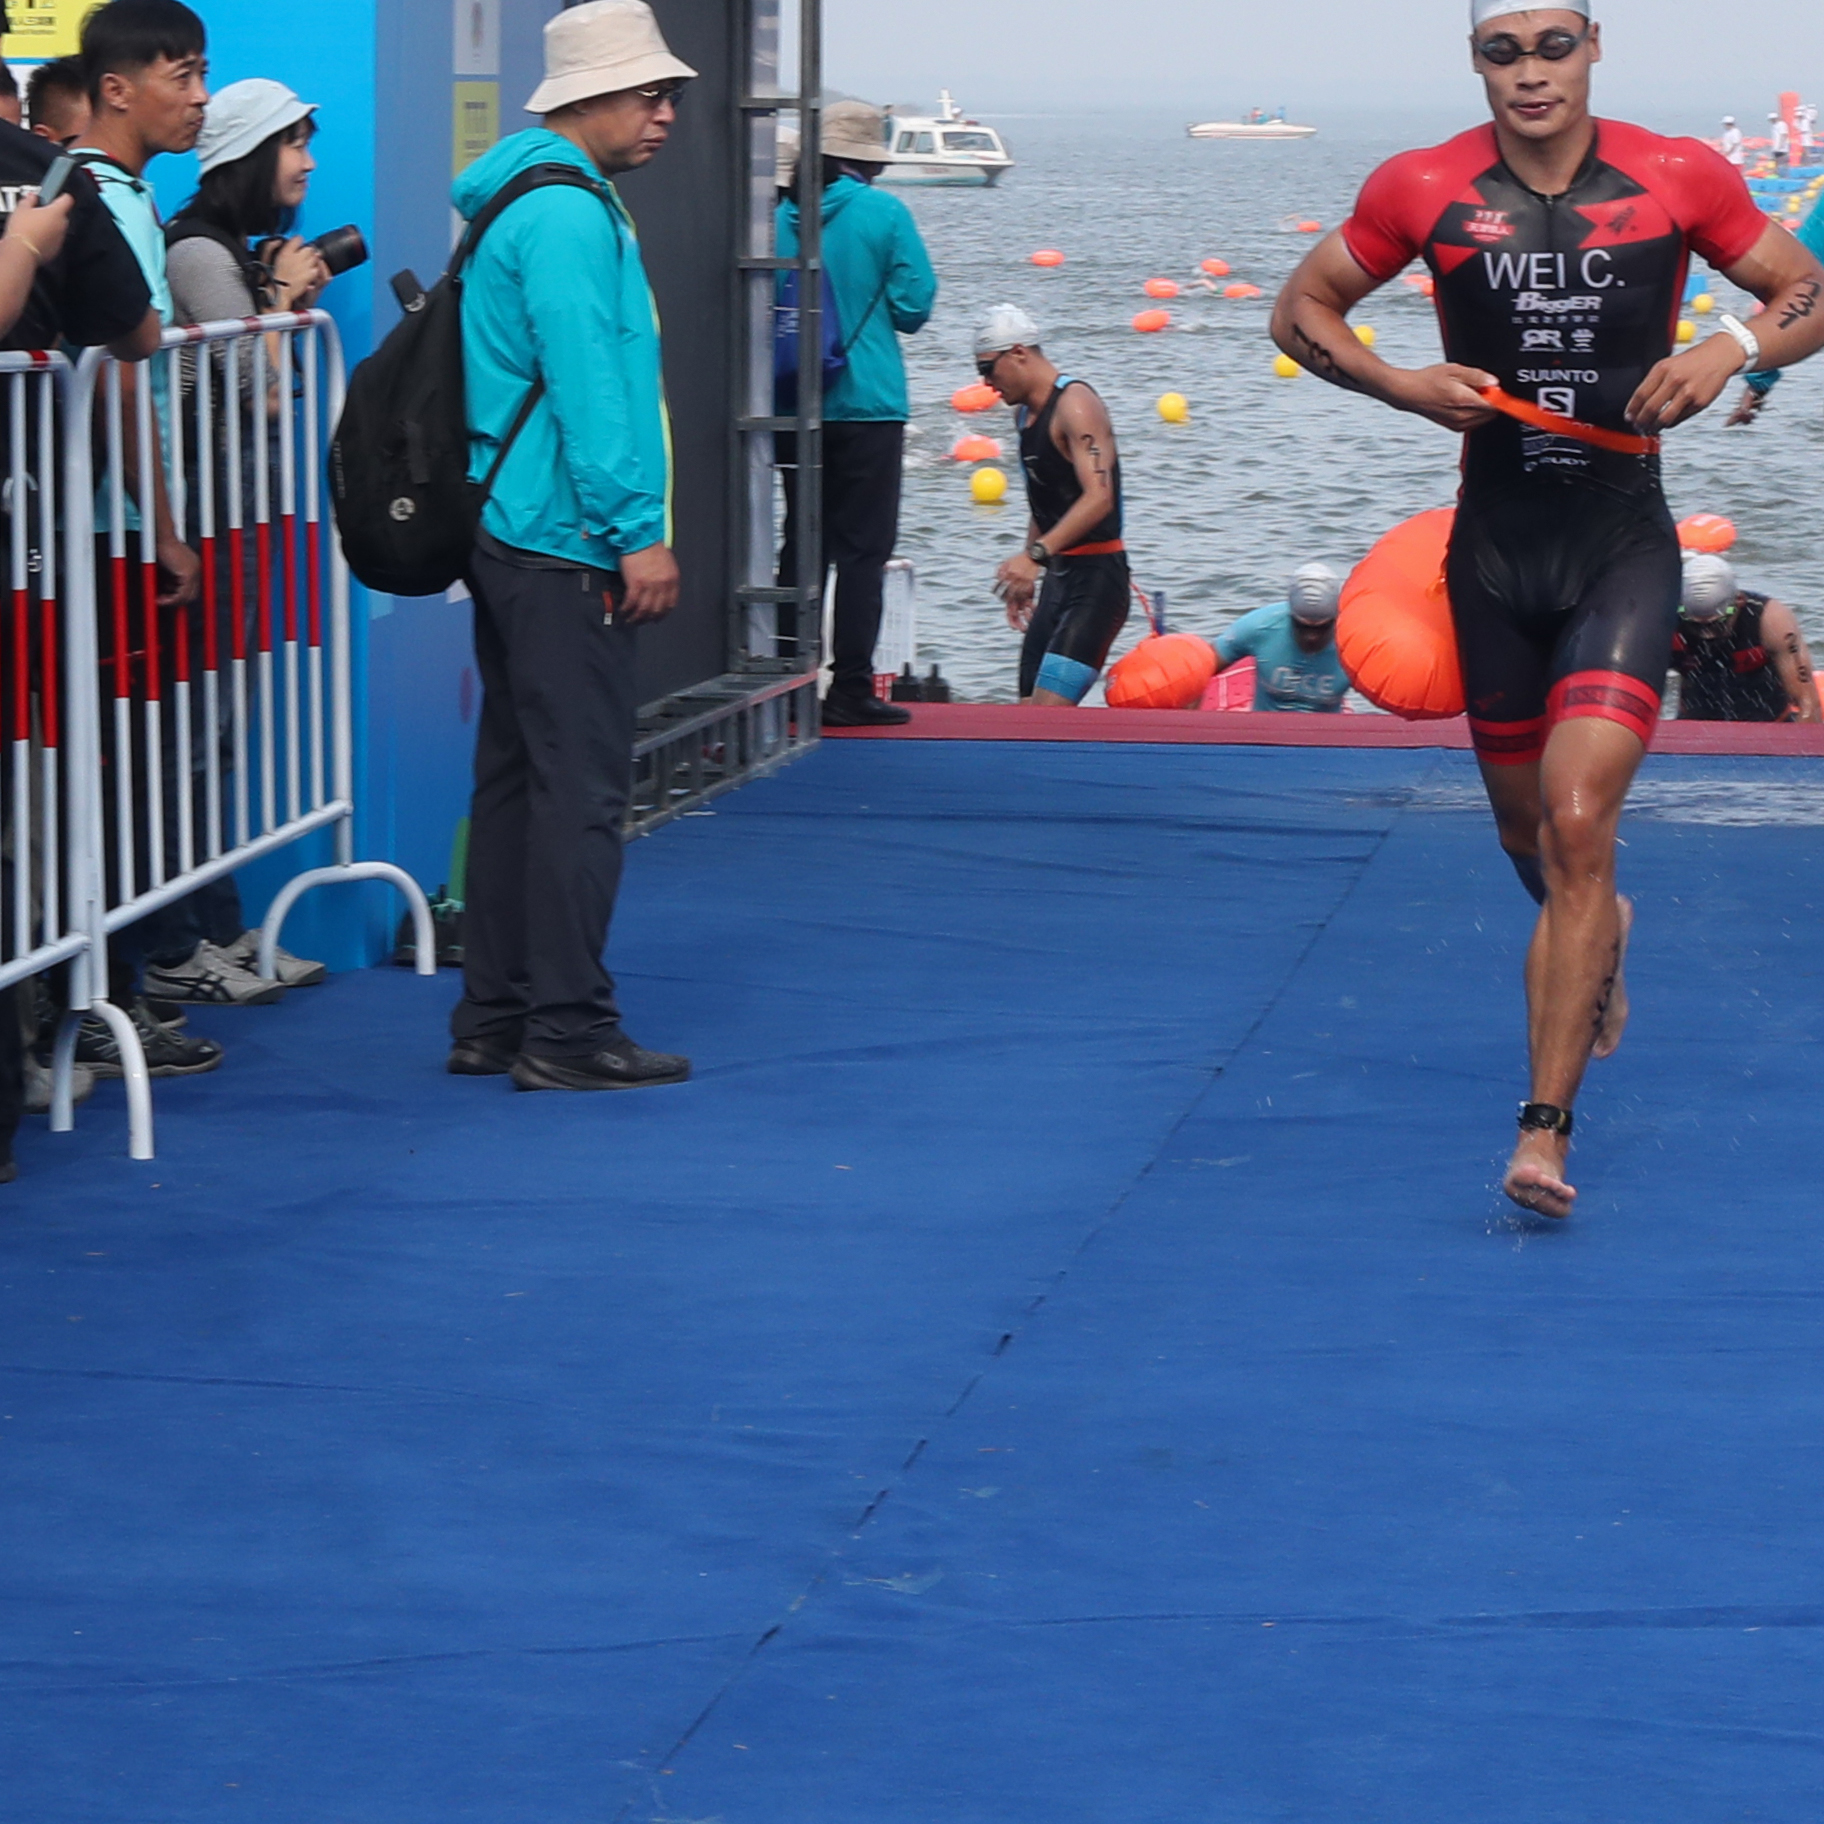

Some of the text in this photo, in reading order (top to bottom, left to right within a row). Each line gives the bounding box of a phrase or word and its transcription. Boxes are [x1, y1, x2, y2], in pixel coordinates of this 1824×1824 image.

[1484, 248, 1626, 290] WEI C.
[1516, 368, 1599, 384] SUUNTO
